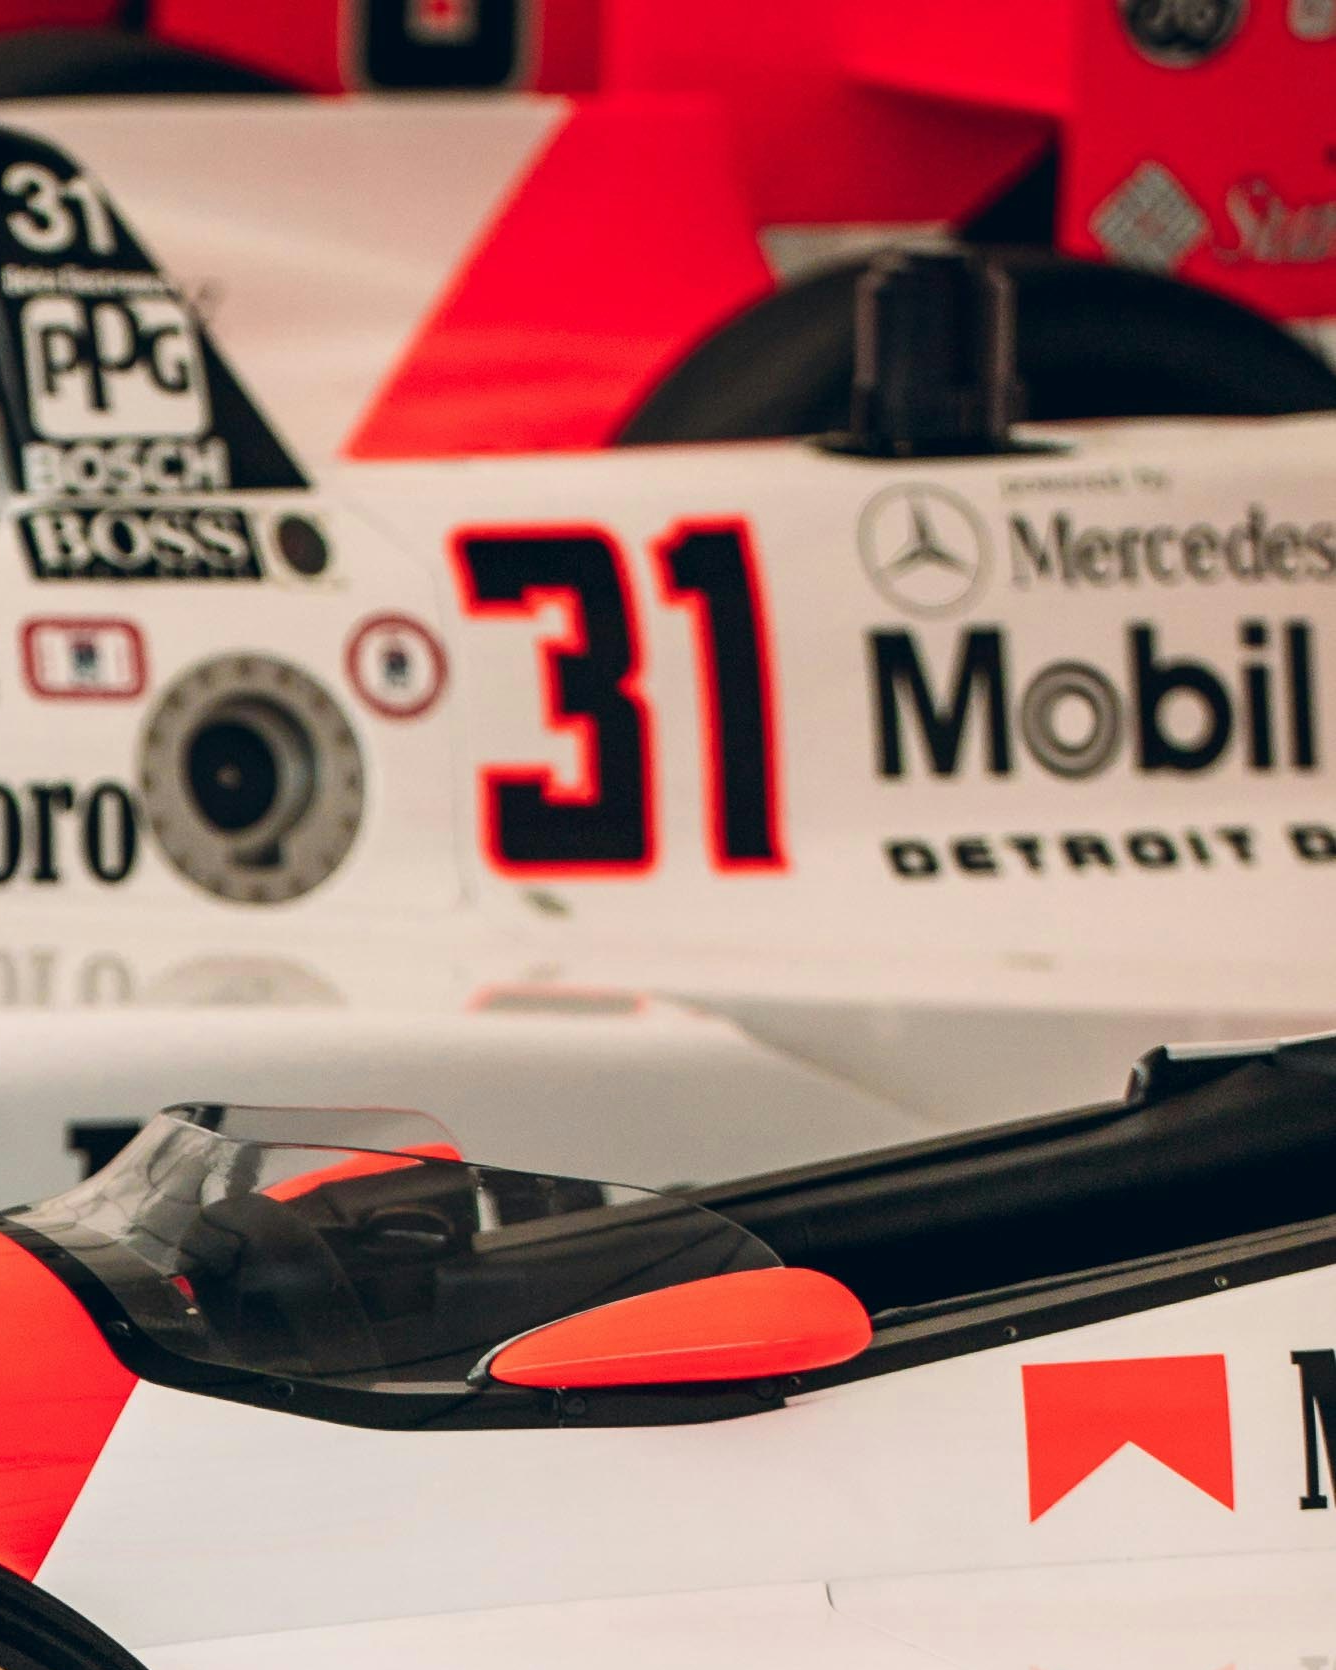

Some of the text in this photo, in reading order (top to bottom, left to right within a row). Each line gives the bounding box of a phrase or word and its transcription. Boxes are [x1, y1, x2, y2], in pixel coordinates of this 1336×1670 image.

[0, 161, 117, 256] 31
[23, 441, 227, 494] BOSCH
[30, 508, 249, 569] BOSS
[1009, 503, 1336, 588] Mercedes
[449, 514, 793, 876] 31
[868, 619, 1318, 780] Mobil
[885, 824, 1265, 880] DETROIT
